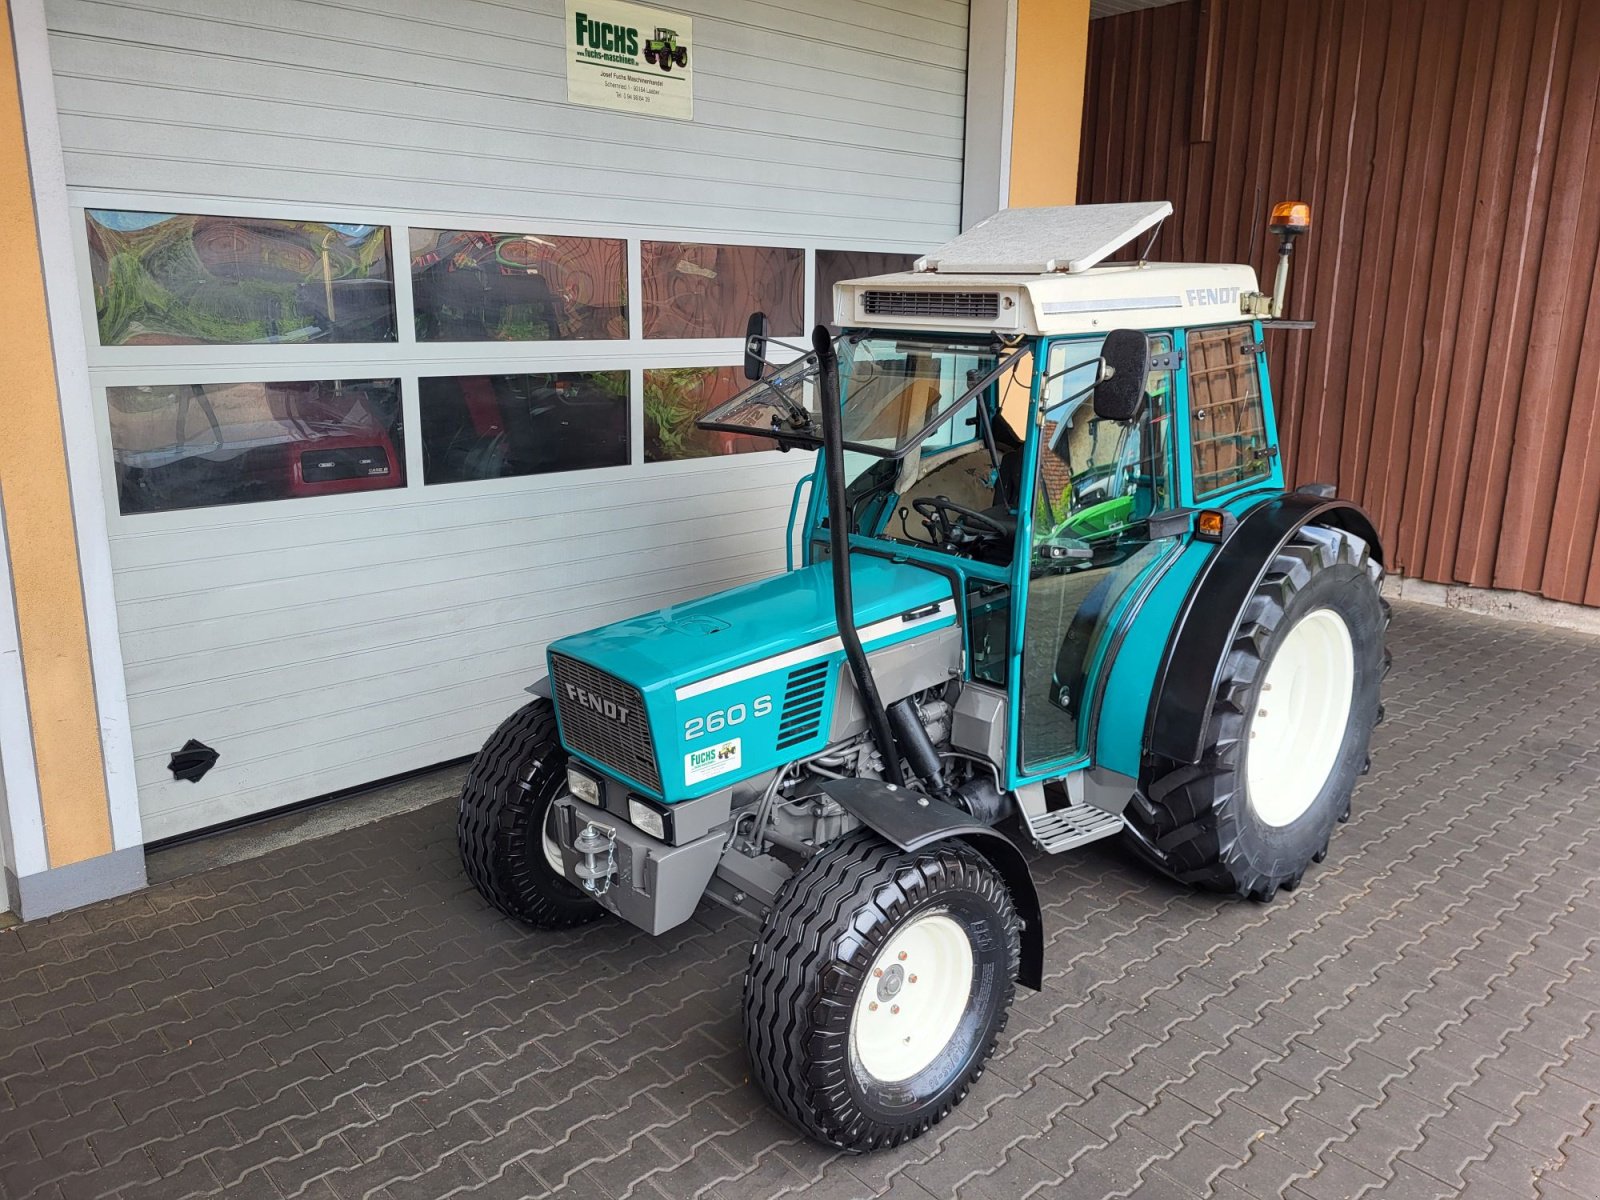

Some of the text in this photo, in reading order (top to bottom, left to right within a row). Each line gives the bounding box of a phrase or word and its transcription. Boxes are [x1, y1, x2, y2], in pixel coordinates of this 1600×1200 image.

[600, 71, 664, 87] Josef Fuchs Maschinenhandel
[1185, 286, 1241, 307] FENDT
[565, 682, 629, 724] FENDT
[684, 694, 773, 741] 260 S
